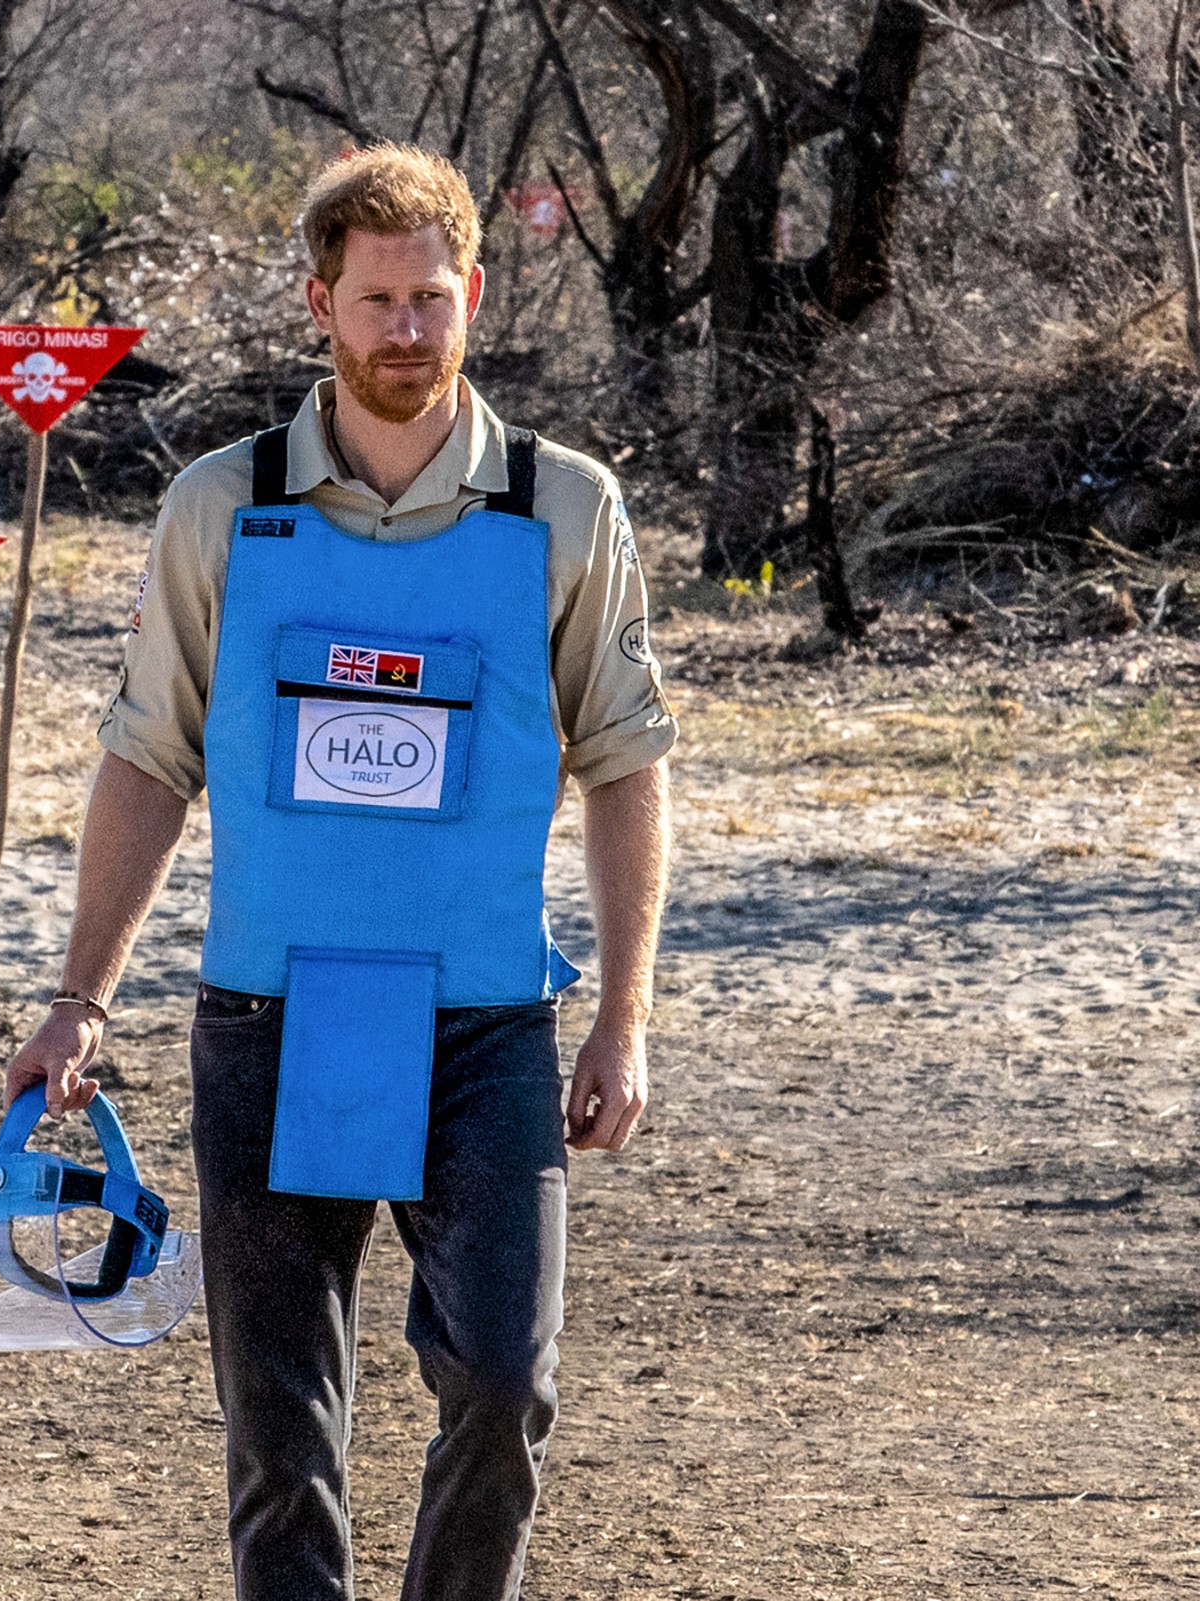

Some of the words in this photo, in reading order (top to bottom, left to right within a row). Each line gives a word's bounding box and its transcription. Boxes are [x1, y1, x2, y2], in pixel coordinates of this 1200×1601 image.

[44, 331, 109, 348] MINAS!
[358, 723, 384, 736] THE
[328, 736, 420, 768] HALO
[351, 770, 392, 784] TRUST
